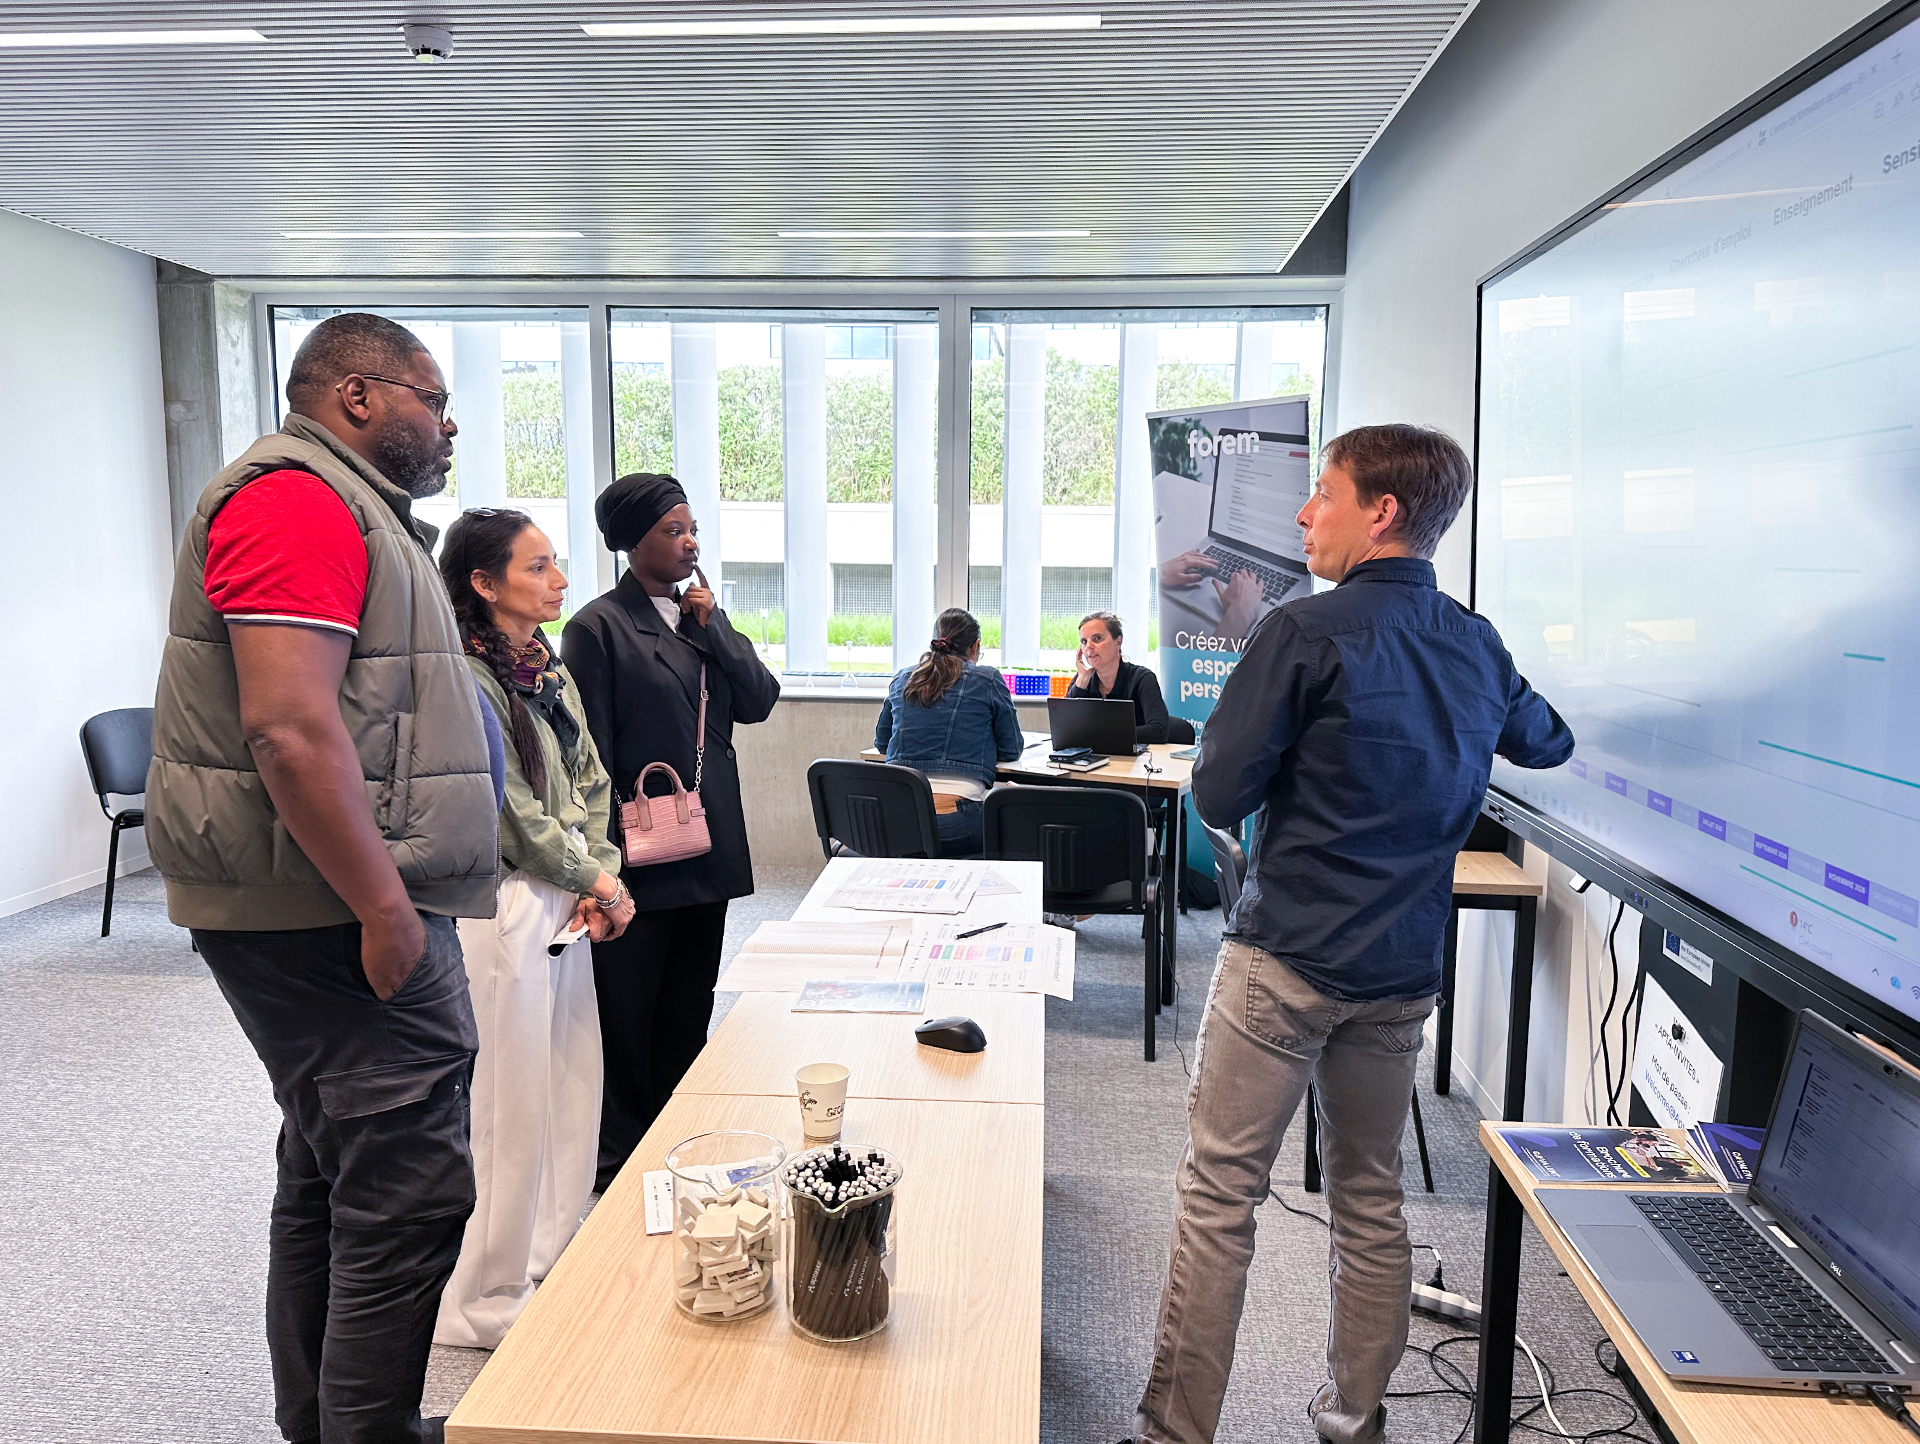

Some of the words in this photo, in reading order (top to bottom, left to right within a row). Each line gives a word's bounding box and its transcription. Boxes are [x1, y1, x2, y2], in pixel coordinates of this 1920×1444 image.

[1774, 173, 1854, 226] Enseignement
[1670, 245, 1712, 274] Chercheur
[1713, 222, 1752, 253] d'emploi
[1188, 429, 1260, 458] forem
[1175, 630, 1227, 652] Créez
[1651, 1054, 1662, 1075] Mot
[1662, 1072, 1670, 1085] de
[1569, 1131, 1582, 1140] de
[1576, 1140, 1617, 1178] formations
[1596, 1146, 1632, 1179] Brochure
[1830, 1262, 1842, 1277] DELL
